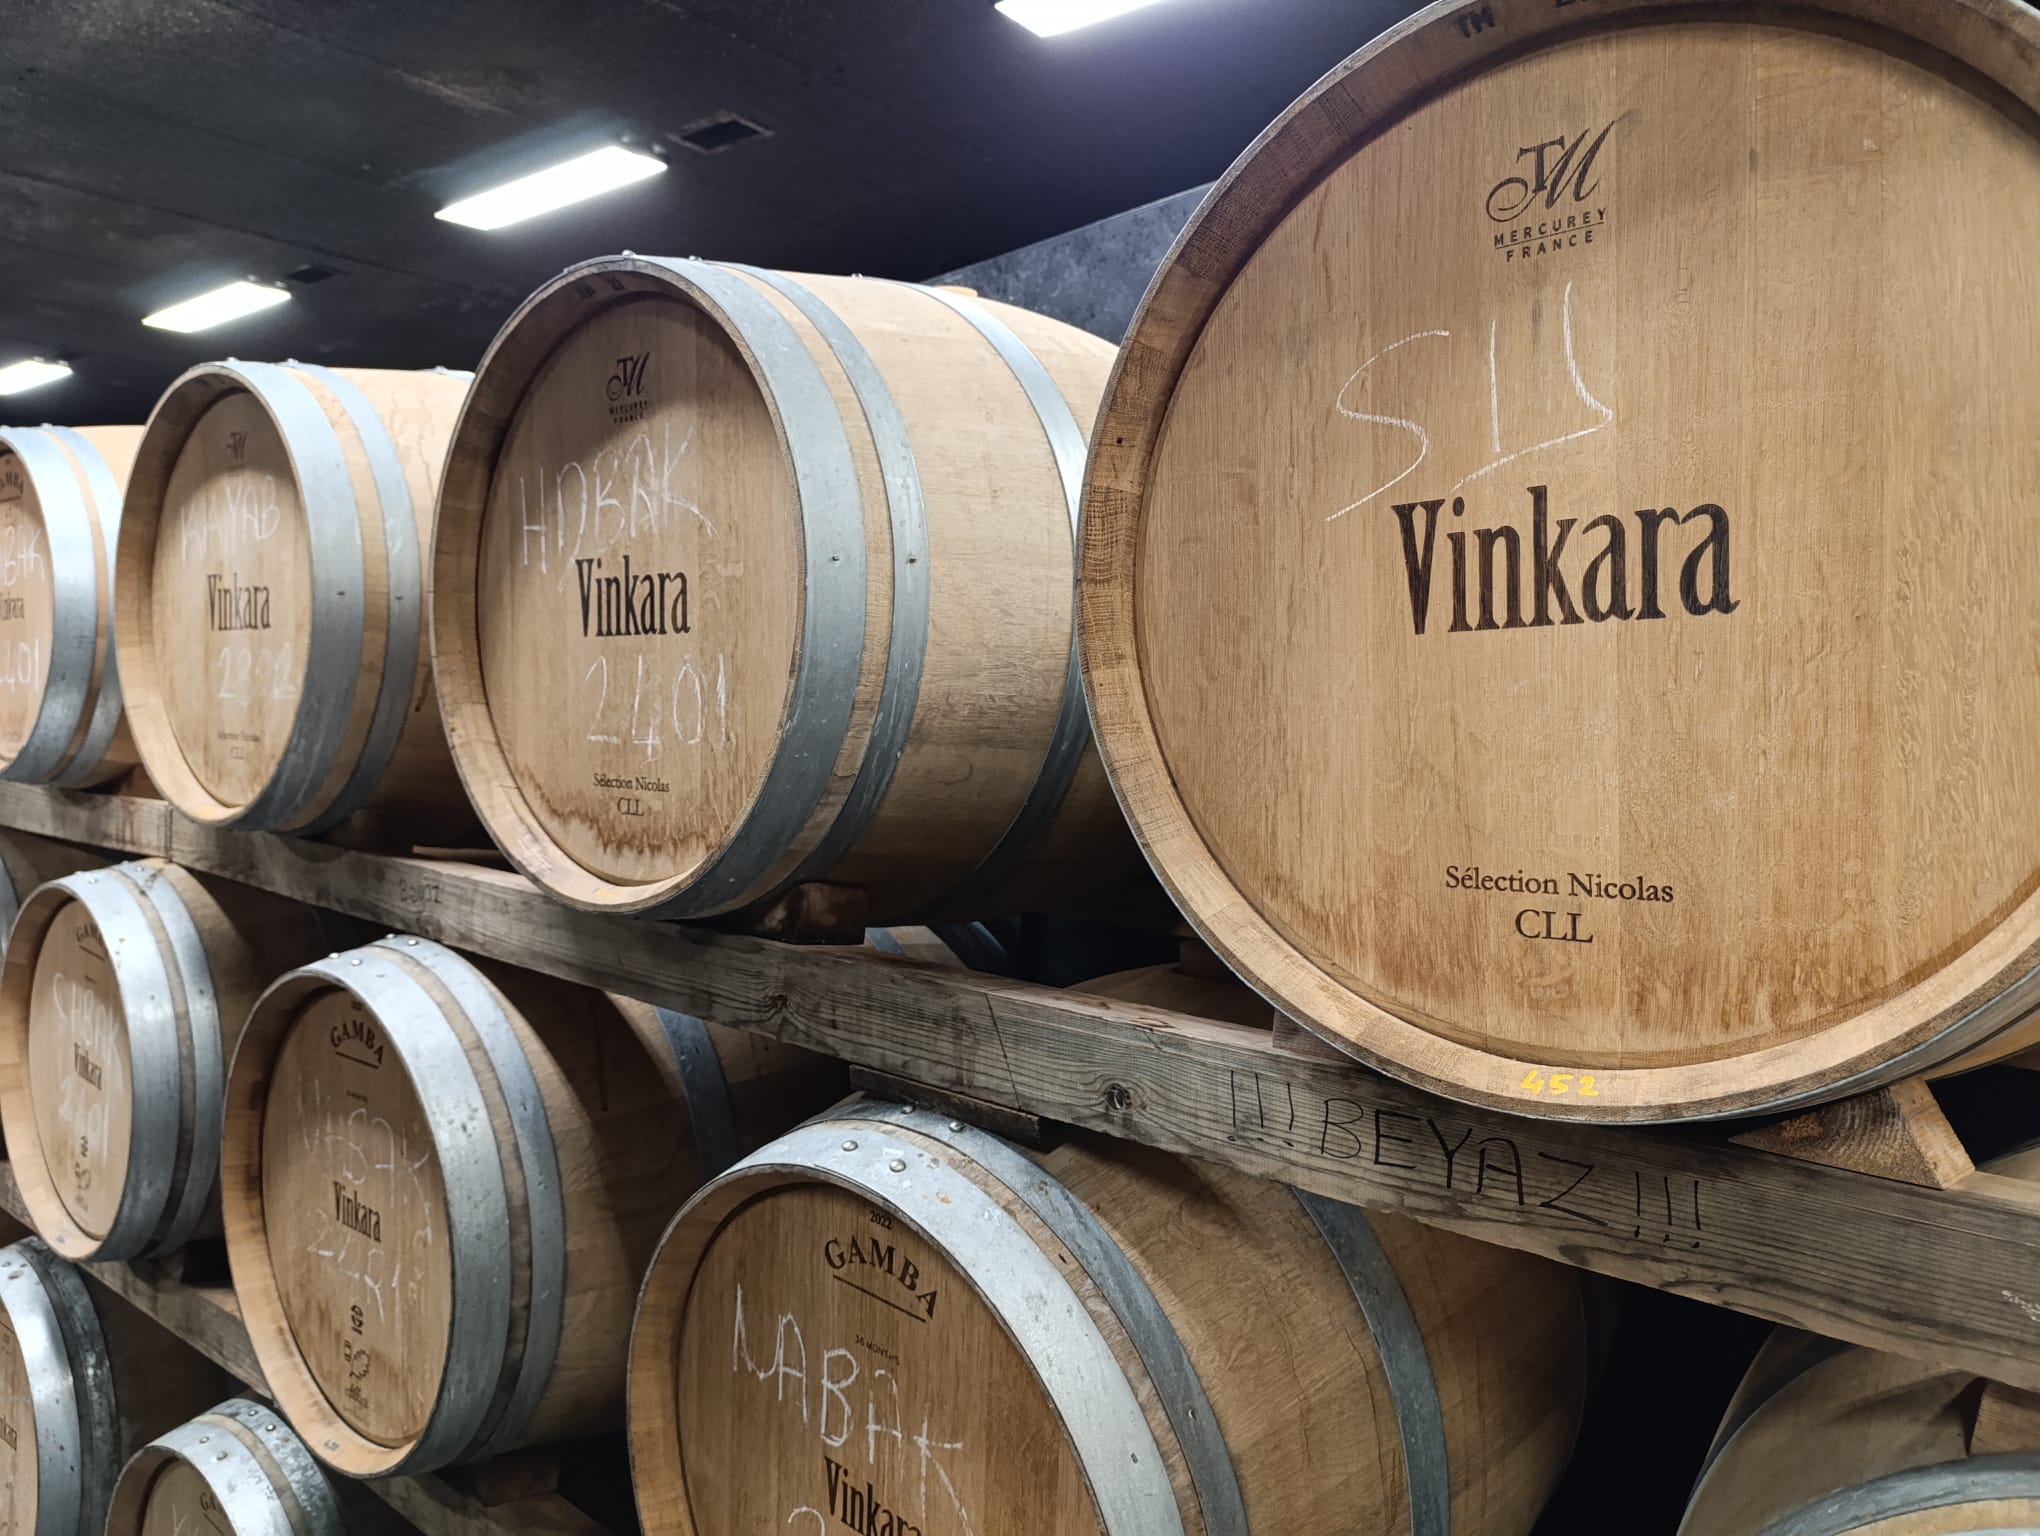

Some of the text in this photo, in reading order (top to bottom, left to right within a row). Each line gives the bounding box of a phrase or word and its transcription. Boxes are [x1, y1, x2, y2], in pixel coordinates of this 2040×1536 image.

[1494, 207, 1606, 247] MERCUREY
[1506, 230, 1593, 262] FRANCE
[1391, 485, 1741, 635] Vinkara
[207, 572, 271, 631] Vinkara
[575, 555, 691, 637] Vinkara
[635, 776, 670, 793] Nicolas
[617, 797, 645, 817] CLL
[1445, 865, 1674, 903] Sélection Nicolas
[1514, 908, 1594, 943] CLL
[330, 1020, 384, 1065] GAMBA
[1520, 1069, 1600, 1097] 452
[333, 1180, 382, 1244] Vinkara
[870, 1210, 893, 1231] 2022
[824, 1235, 938, 1320] GAMBA
[866, 1339, 901, 1366] MONTHS
